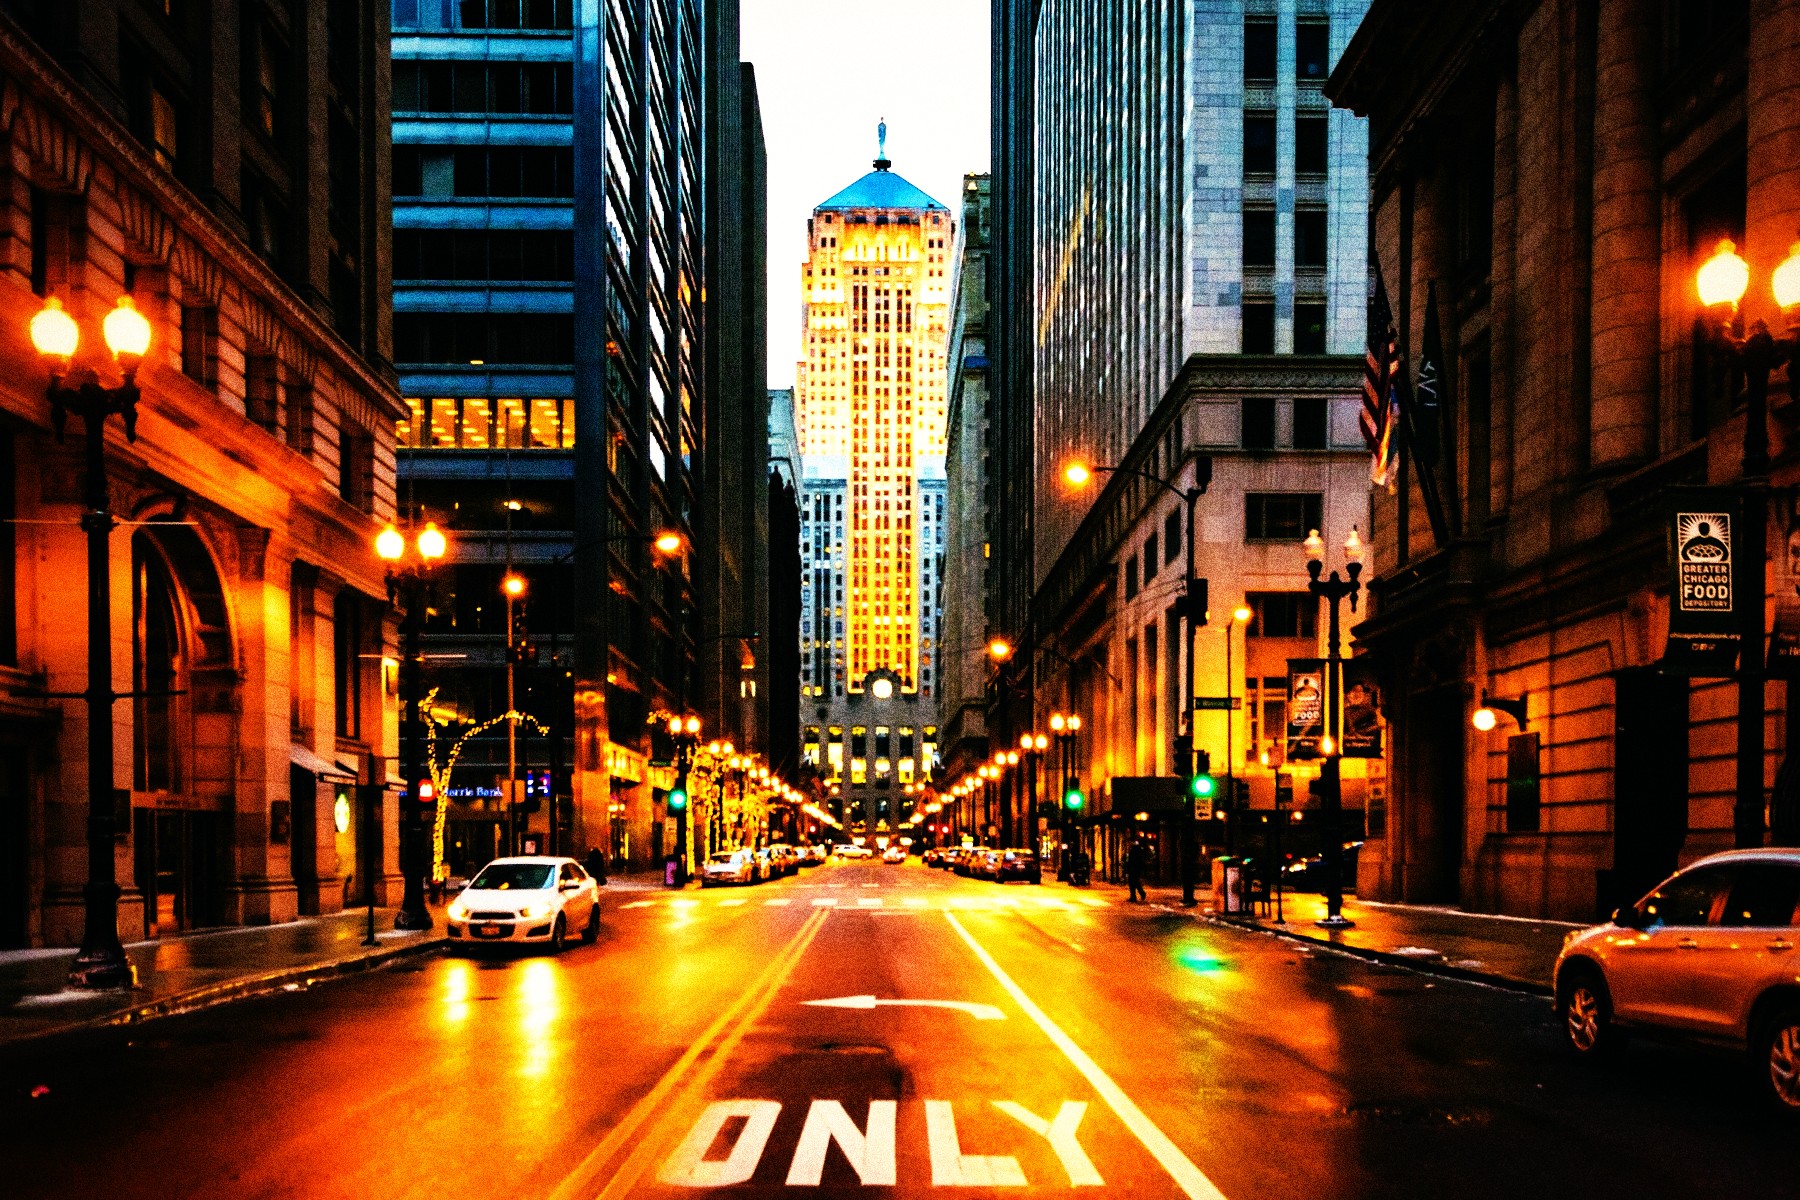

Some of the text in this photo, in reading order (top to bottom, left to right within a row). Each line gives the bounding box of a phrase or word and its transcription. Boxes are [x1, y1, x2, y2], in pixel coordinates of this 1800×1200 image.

[1683, 564, 1727, 573] GREATER
[1683, 575, 1728, 583] CHICAGO
[1683, 584, 1729, 599] FOOD
[476, 786, 503, 797] Bank
[655, 1099, 1106, 1188] ONLY
